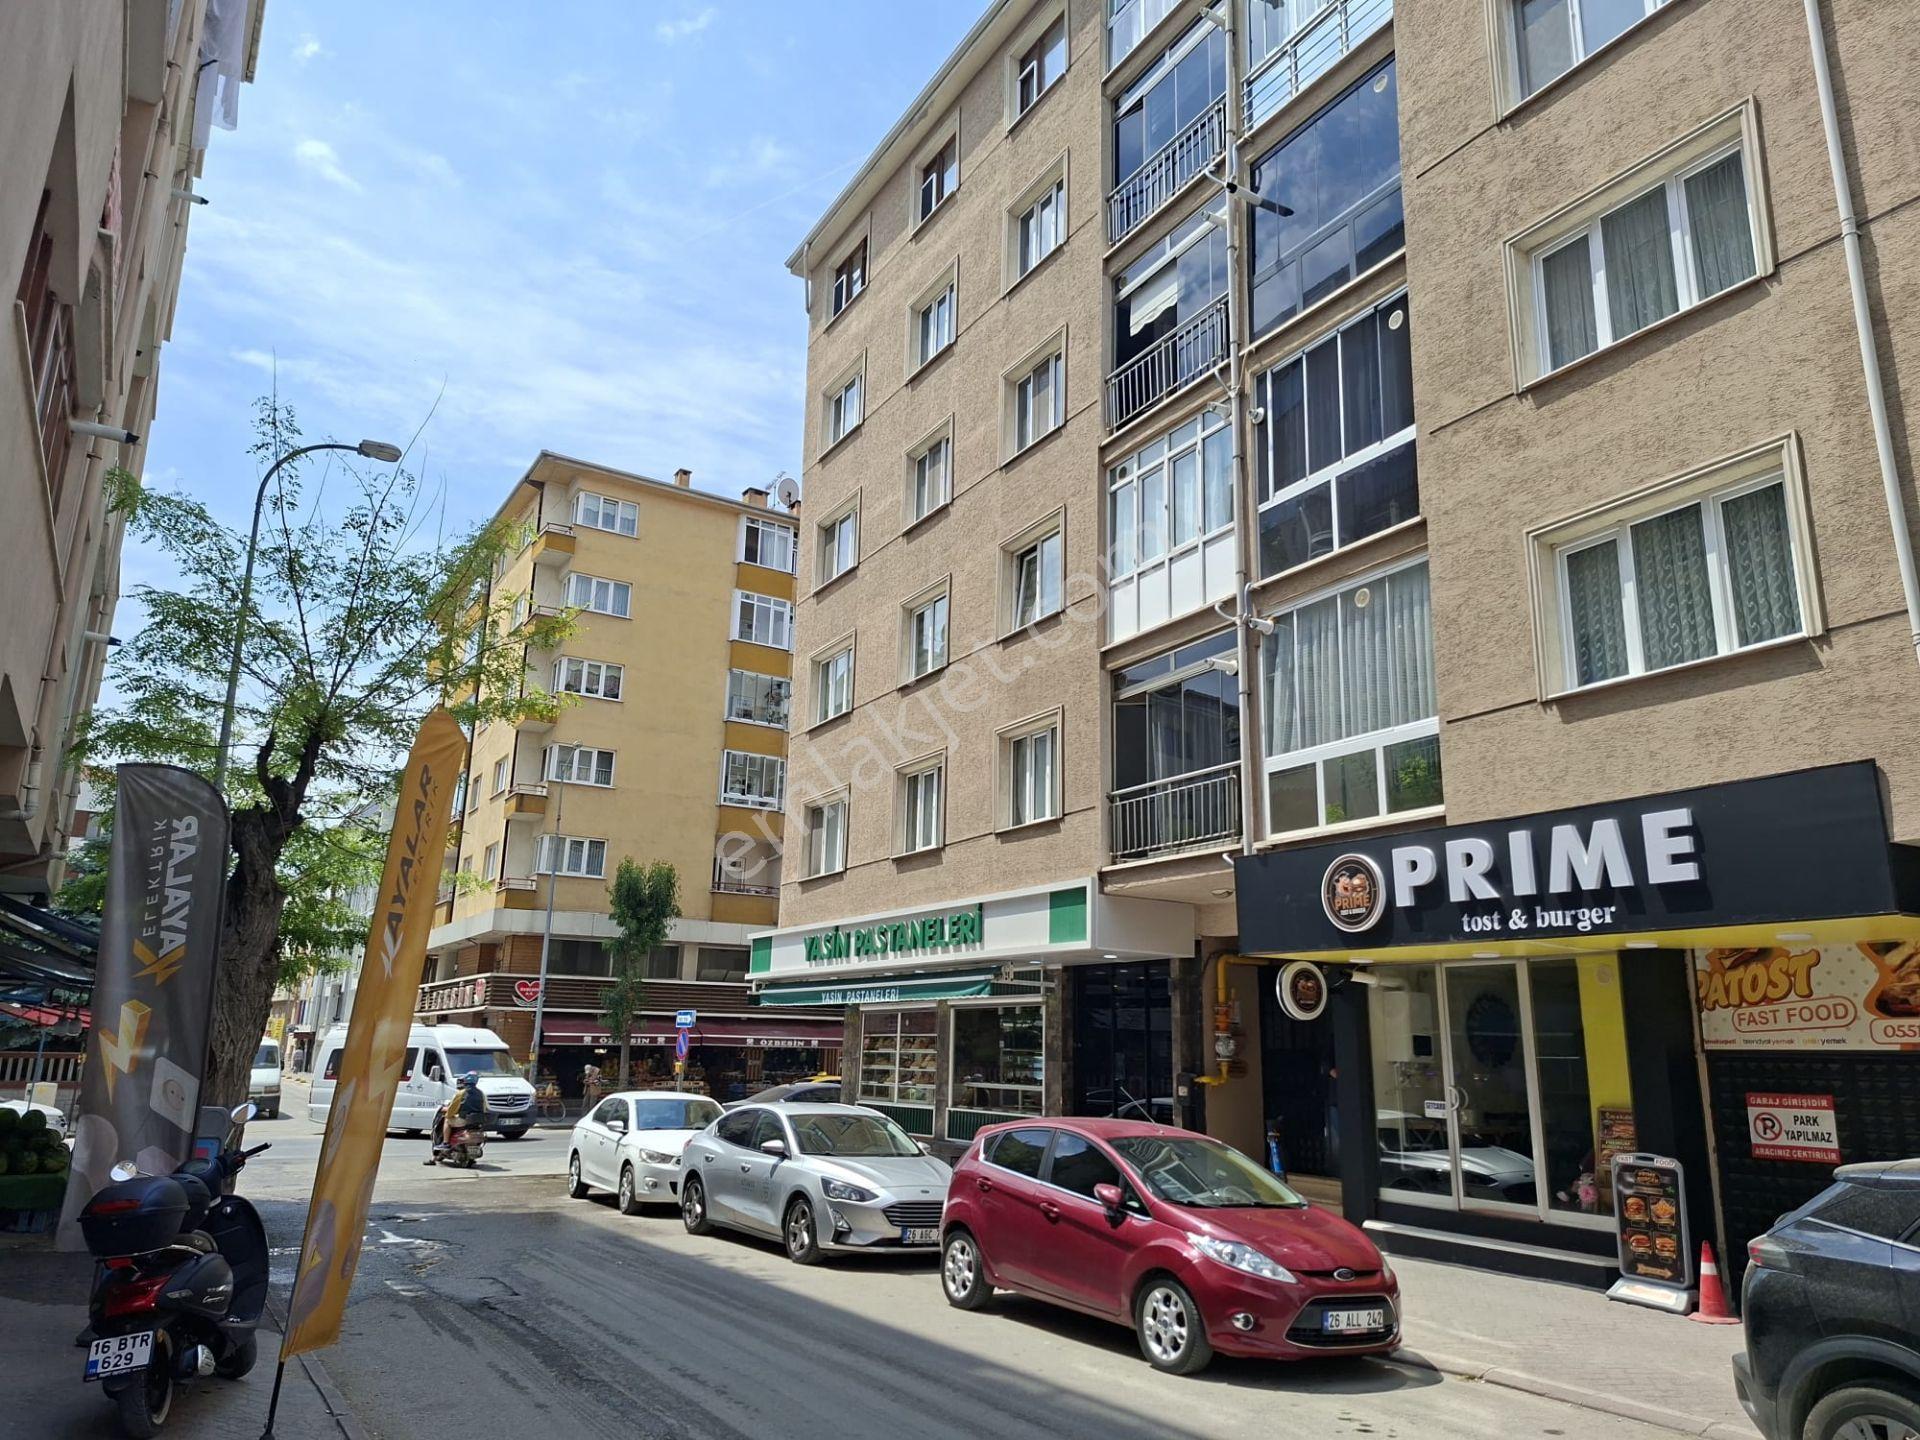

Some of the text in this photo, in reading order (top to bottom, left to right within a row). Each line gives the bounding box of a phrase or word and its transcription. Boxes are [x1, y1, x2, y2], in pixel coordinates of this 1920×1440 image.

[1392, 808, 1699, 908] PRIME
[1334, 894, 1371, 911] PRIME
[1461, 905, 1617, 932] tost & burger
[803, 903, 983, 962] YASİN PASTANELERİ
[821, 986, 900, 1003] YASİN PASTANELERİ
[1737, 1003, 1849, 1027] FAST FOOD
[1883, 1024, 1920, 1039] 055
[1750, 1097, 1779, 1106] GARAJ
[1793, 1115, 1820, 1127] PARK
[1784, 1129, 1833, 1143] YAPILMAZ
[1329, 1313, 1340, 1329] 26
[1346, 1312, 1362, 1327] ALL
[94, 1333, 151, 1356] 16 BTR
[101, 1352, 134, 1370] 629
